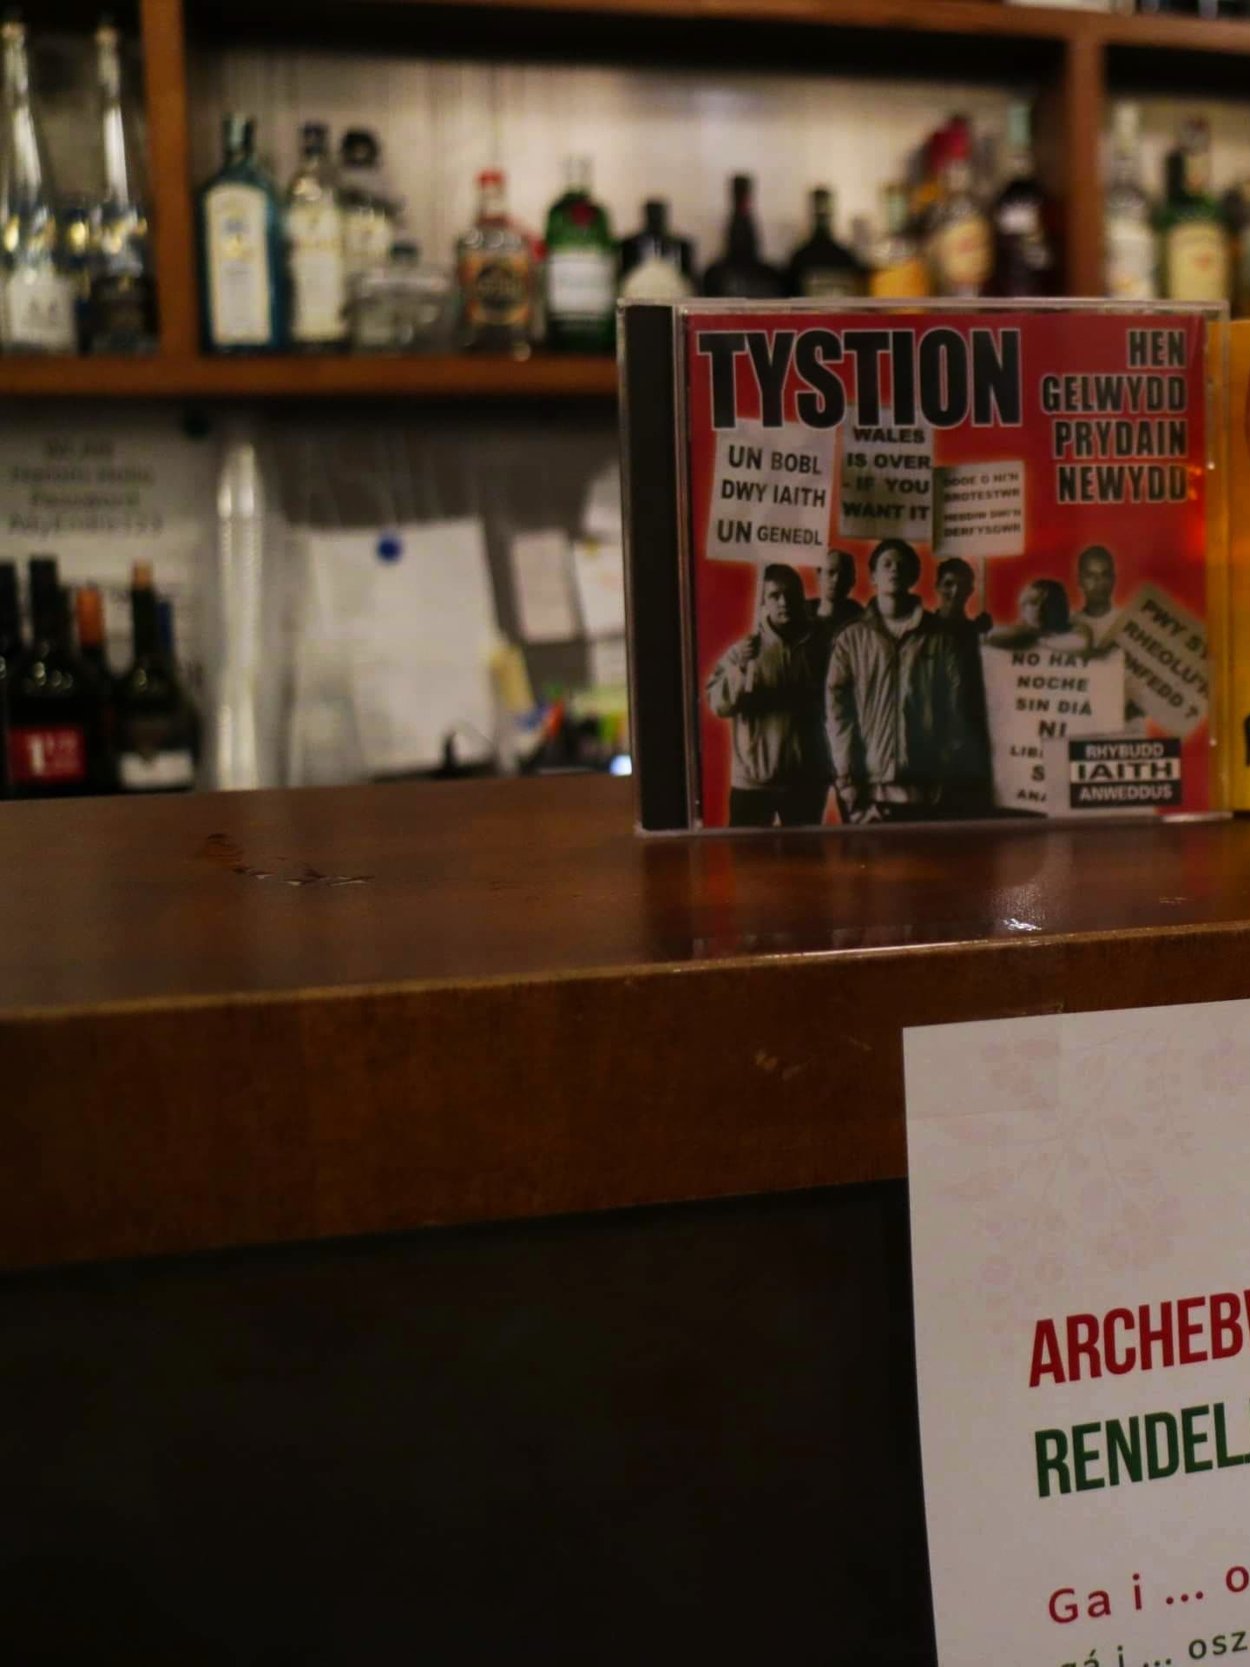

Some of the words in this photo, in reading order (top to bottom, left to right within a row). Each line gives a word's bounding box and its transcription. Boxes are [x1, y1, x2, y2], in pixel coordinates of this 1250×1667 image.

[1127, 329, 1187, 369] HEN
[696, 327, 1023, 431] TYSTION
[1041, 373, 1187, 414] GELWYDD
[853, 428, 925, 443] WALES
[1053, 418, 1188, 459] PRYDAIN
[728, 445, 763, 470] UN
[770, 452, 822, 475] BOBL
[847, 453, 867, 468] IS
[874, 453, 931, 469] OVER
[884, 478, 929, 494] YOU
[1056, 463, 1188, 504] NEWYDD
[721, 480, 767, 503] DWY
[773, 483, 826, 507] IAITH
[842, 502, 904, 519] WANT
[910, 504, 930, 520] IT
[717, 519, 752, 544] UN
[756, 524, 823, 546] GENEDL
[1012, 653, 1040, 667] NO
[1050, 653, 1090, 668] HAY
[1017, 676, 1089, 692] NOCHE
[1015, 698, 1050, 712] SIN
[1057, 700, 1092, 716] DIA
[1038, 720, 1067, 738] NI
[1085, 743, 1164, 759] RHYBUDD
[1078, 762, 1172, 780] IAITH
[1079, 785, 1172, 801] ANWEDDUS
[1048, 1587, 1112, 1624] Ga
[1132, 1573, 1142, 1611] i
[1188, 1630, 1248, 1660] osz
